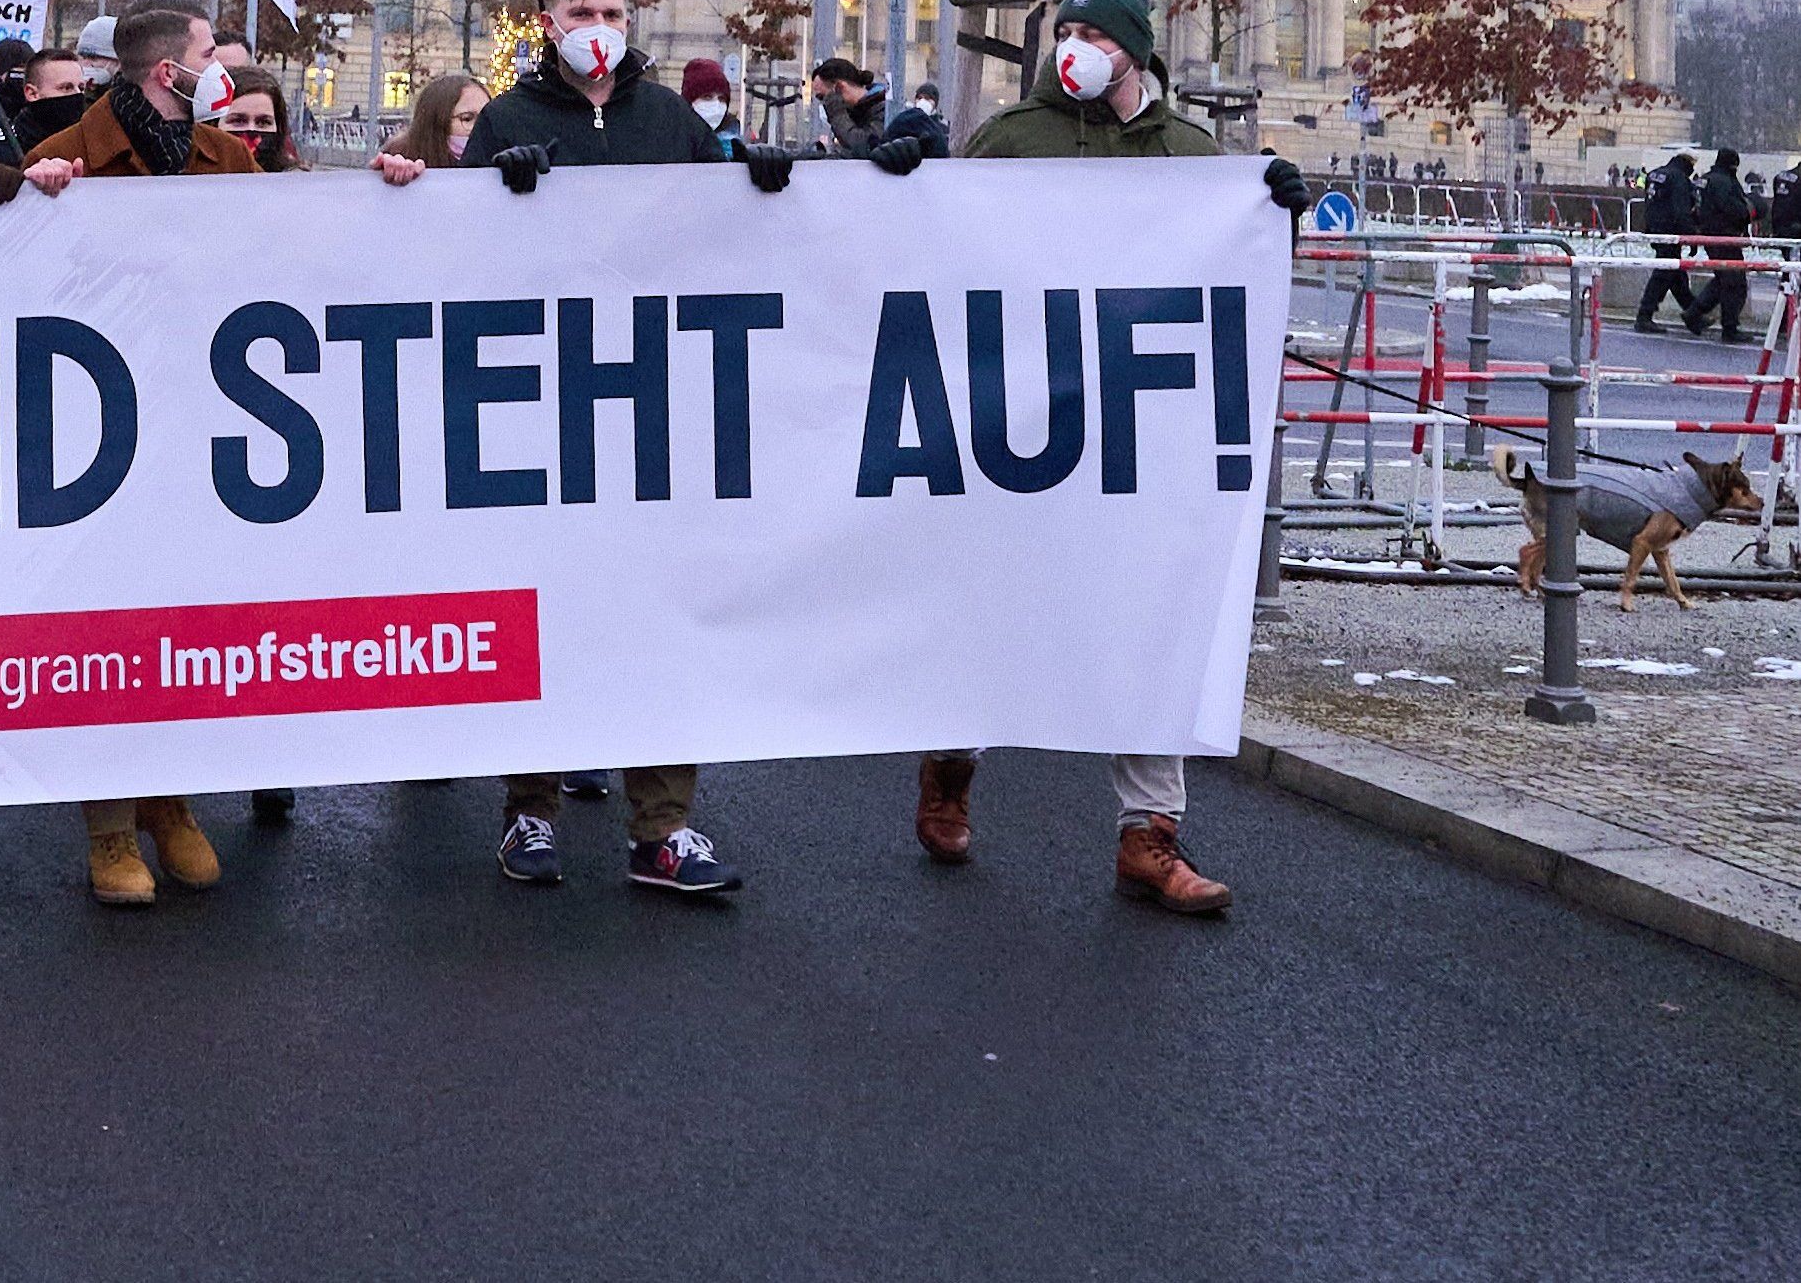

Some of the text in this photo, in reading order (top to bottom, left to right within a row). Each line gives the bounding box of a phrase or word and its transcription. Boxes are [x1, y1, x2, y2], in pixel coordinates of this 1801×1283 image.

[210, 293, 783, 523] STEHT
[856, 286, 1252, 498] AUF!
[160, 621, 497, 697] ImpfstreikDE
